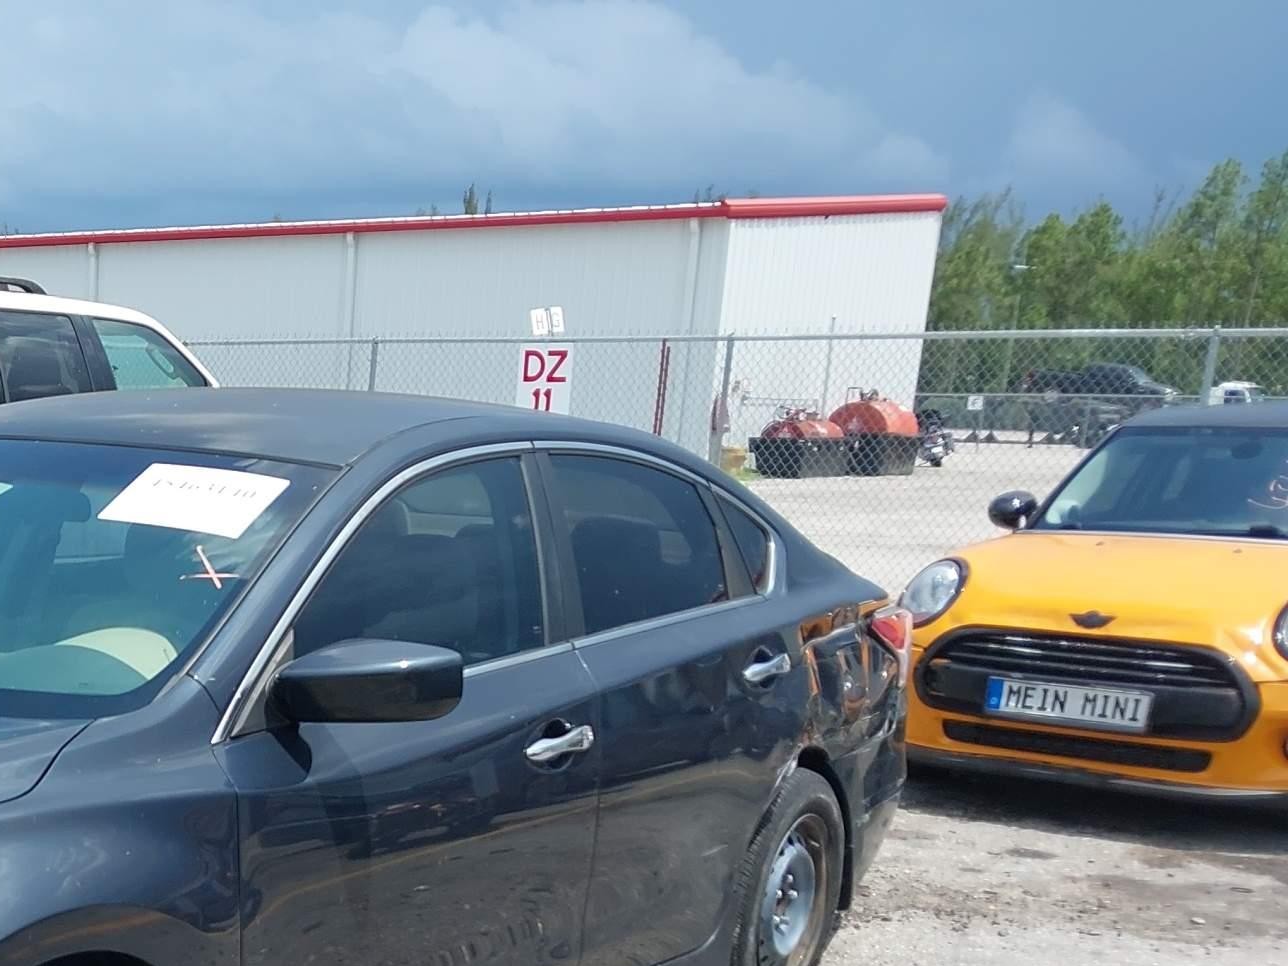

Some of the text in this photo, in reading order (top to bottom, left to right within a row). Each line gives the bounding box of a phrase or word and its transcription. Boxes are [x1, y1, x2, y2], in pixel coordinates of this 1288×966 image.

[522, 350, 569, 383] DZ
[532, 388, 552, 412] 11
[1005, 685, 1069, 713] MEIN
[1080, 693, 1143, 722] MINI
